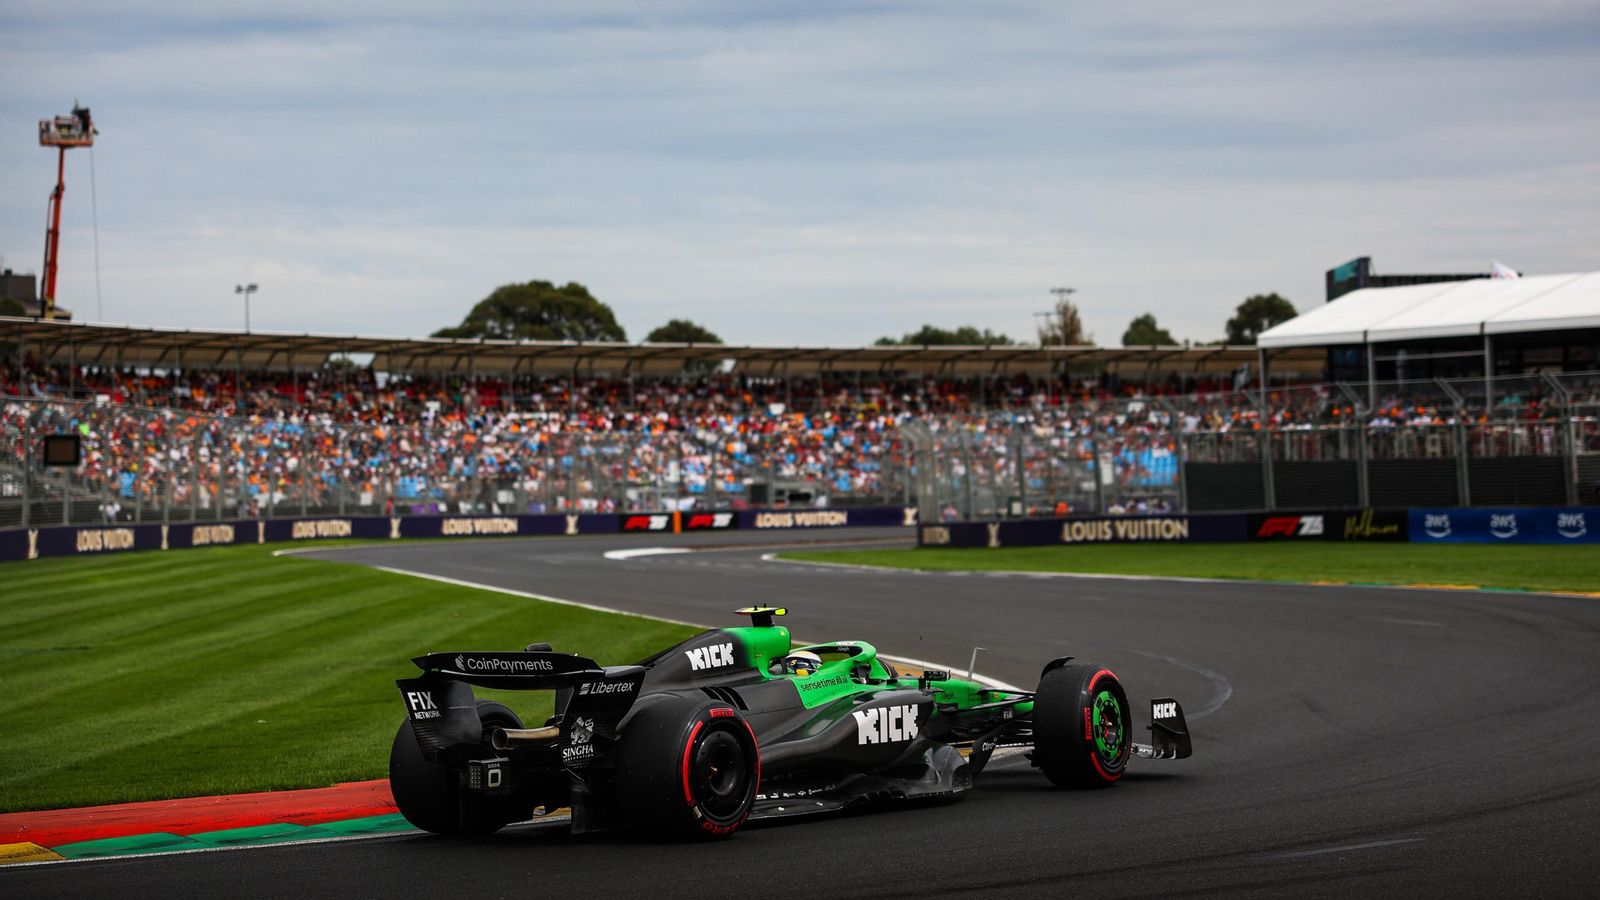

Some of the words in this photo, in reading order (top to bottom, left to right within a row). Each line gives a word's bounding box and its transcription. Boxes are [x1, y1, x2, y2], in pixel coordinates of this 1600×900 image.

[755, 512, 792, 528] LOUIS
[794, 510, 848, 527] VUITTON
[1257, 516, 1300, 537] F1
[1425, 514, 1450, 528] aws
[1490, 514, 1516, 528] aws
[1558, 513, 1585, 528] aws
[1062, 521, 1112, 542] LOUIS
[1114, 519, 1189, 541] VUITTON
[467, 658, 553, 672] CoinPayments
[685, 643, 734, 671] KICK
[590, 682, 634, 695] Libertex
[407, 691, 438, 711] FIX
[414, 711, 441, 720] NETWORK
[1153, 702, 1177, 719] KICK
[852, 703, 919, 745] KICK
[562, 744, 594, 759] SINGHA
